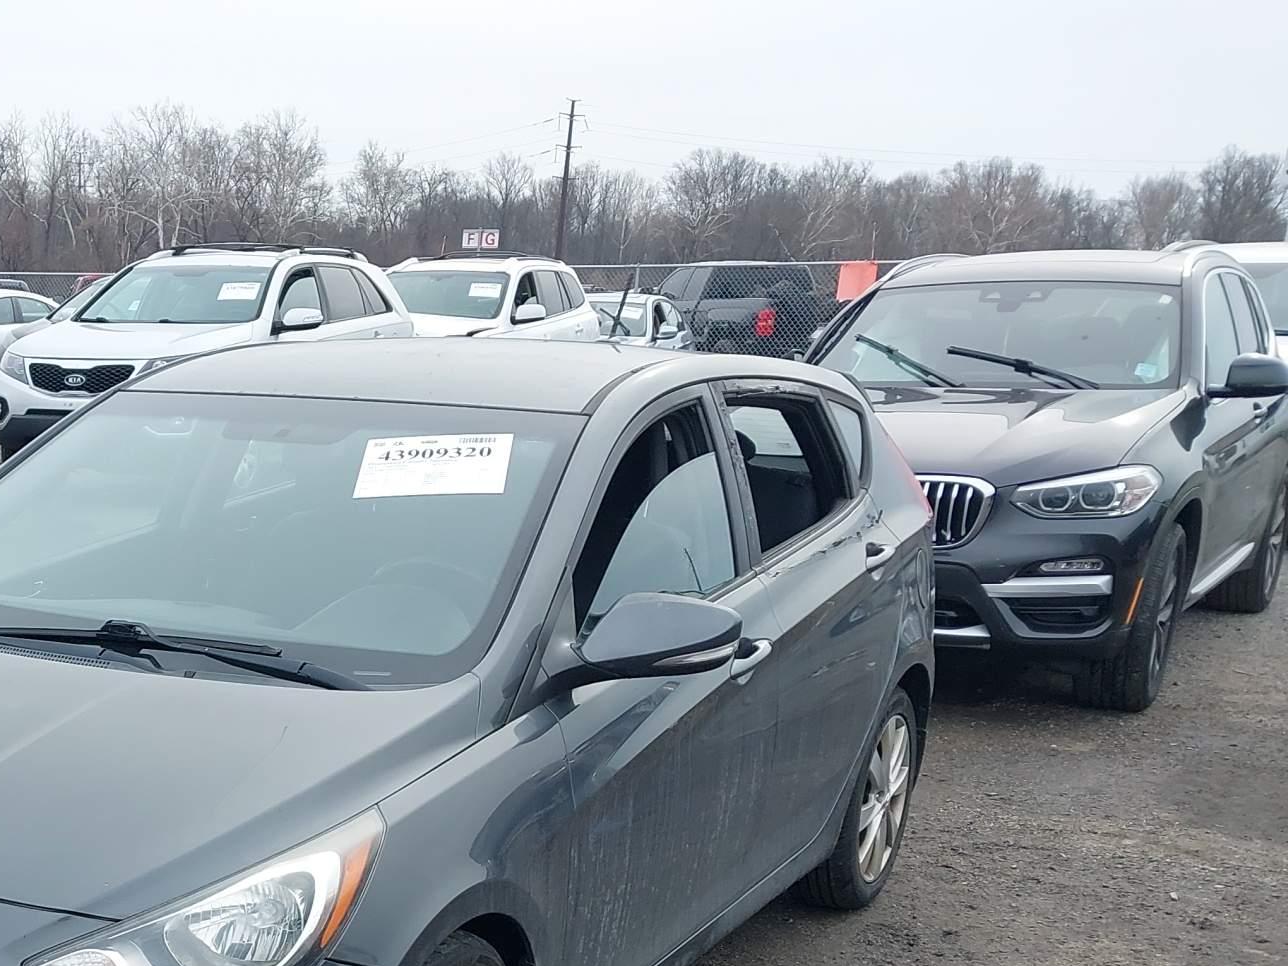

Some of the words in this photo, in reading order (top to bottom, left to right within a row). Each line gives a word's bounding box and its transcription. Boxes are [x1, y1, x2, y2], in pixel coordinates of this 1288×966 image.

[467, 233, 476, 246] F
[485, 232, 496, 246] G
[377, 446, 493, 462] 43909320
